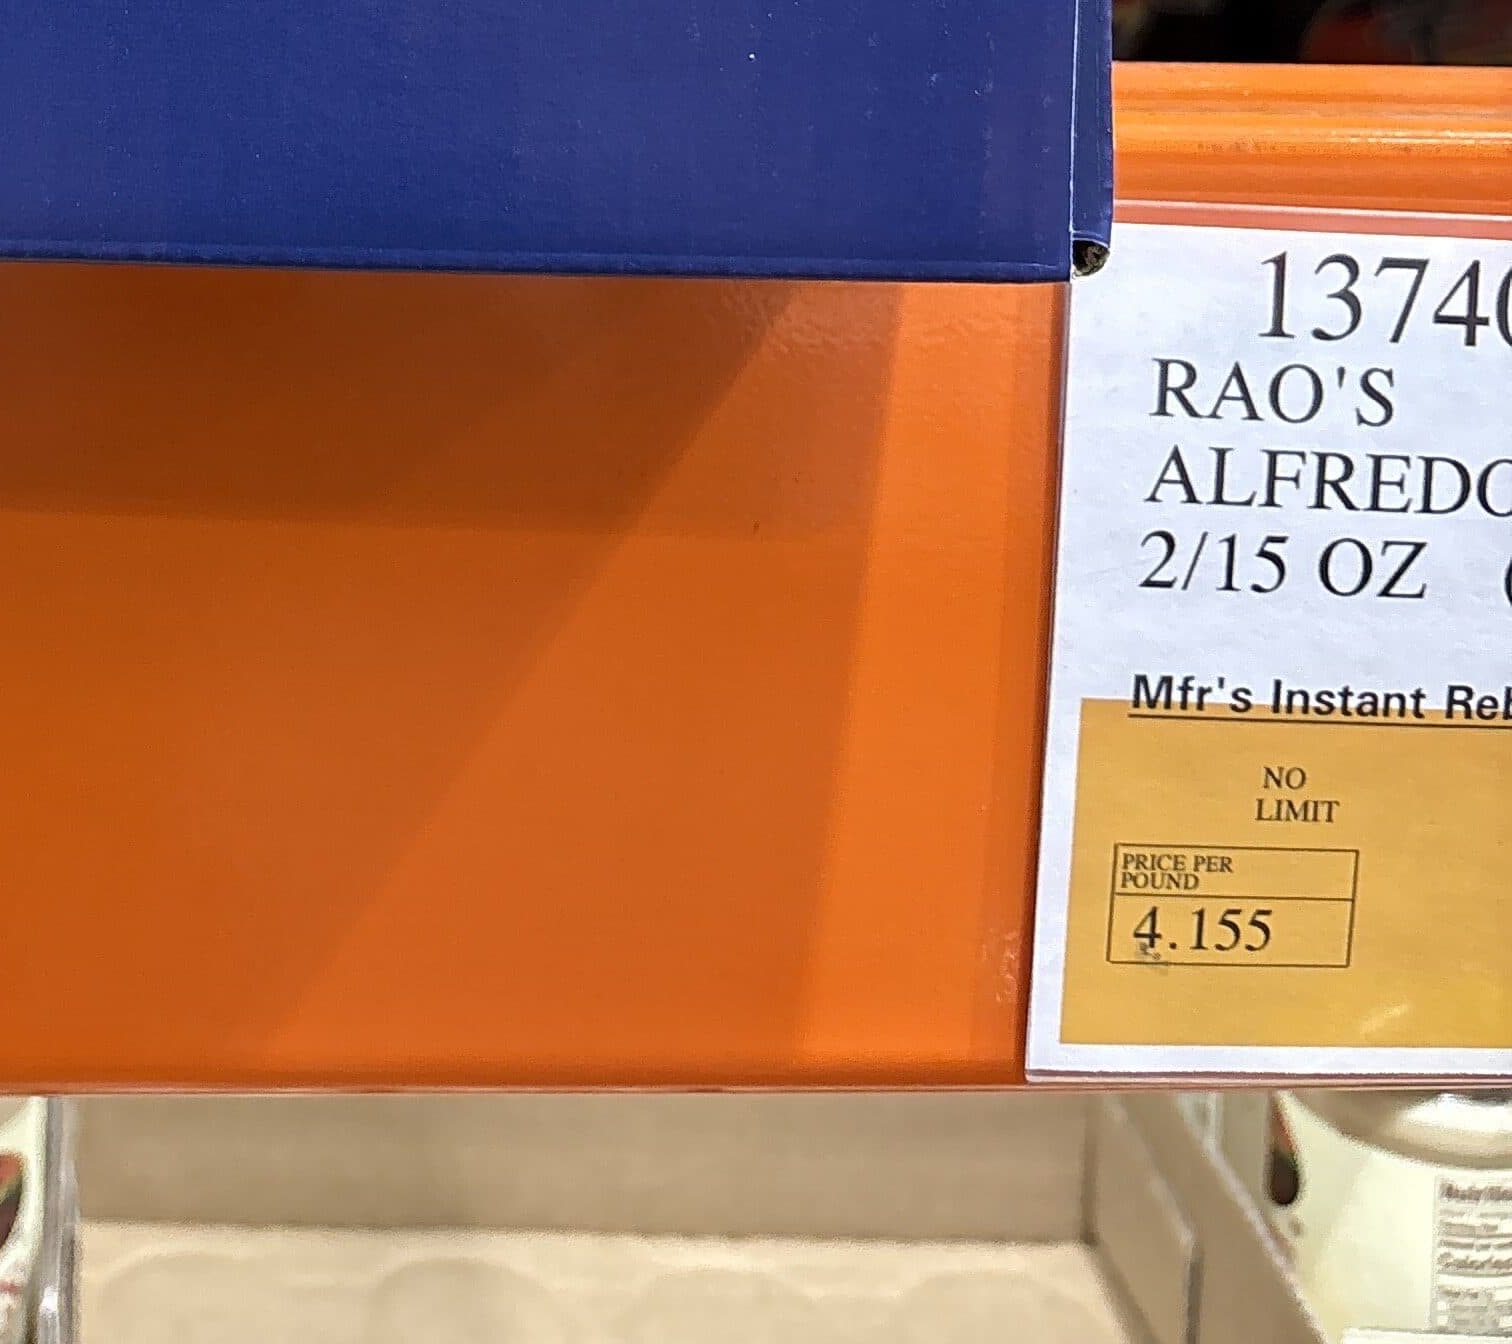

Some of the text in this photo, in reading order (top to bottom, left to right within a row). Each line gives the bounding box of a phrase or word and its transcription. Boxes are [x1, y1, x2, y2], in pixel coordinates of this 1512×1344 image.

[1149, 357, 1395, 427] RAO'S
[1139, 530, 1428, 599] 2/15 OZ
[1131, 674, 1254, 713] Mfr's
[1272, 679, 1426, 719] Instant
[1263, 766, 1307, 790] NO
[1255, 798, 1340, 823] LIMIT
[1122, 852, 1234, 873] PRICE PER
[1120, 872, 1200, 890] POUND
[1133, 906, 1273, 952] 4.155
